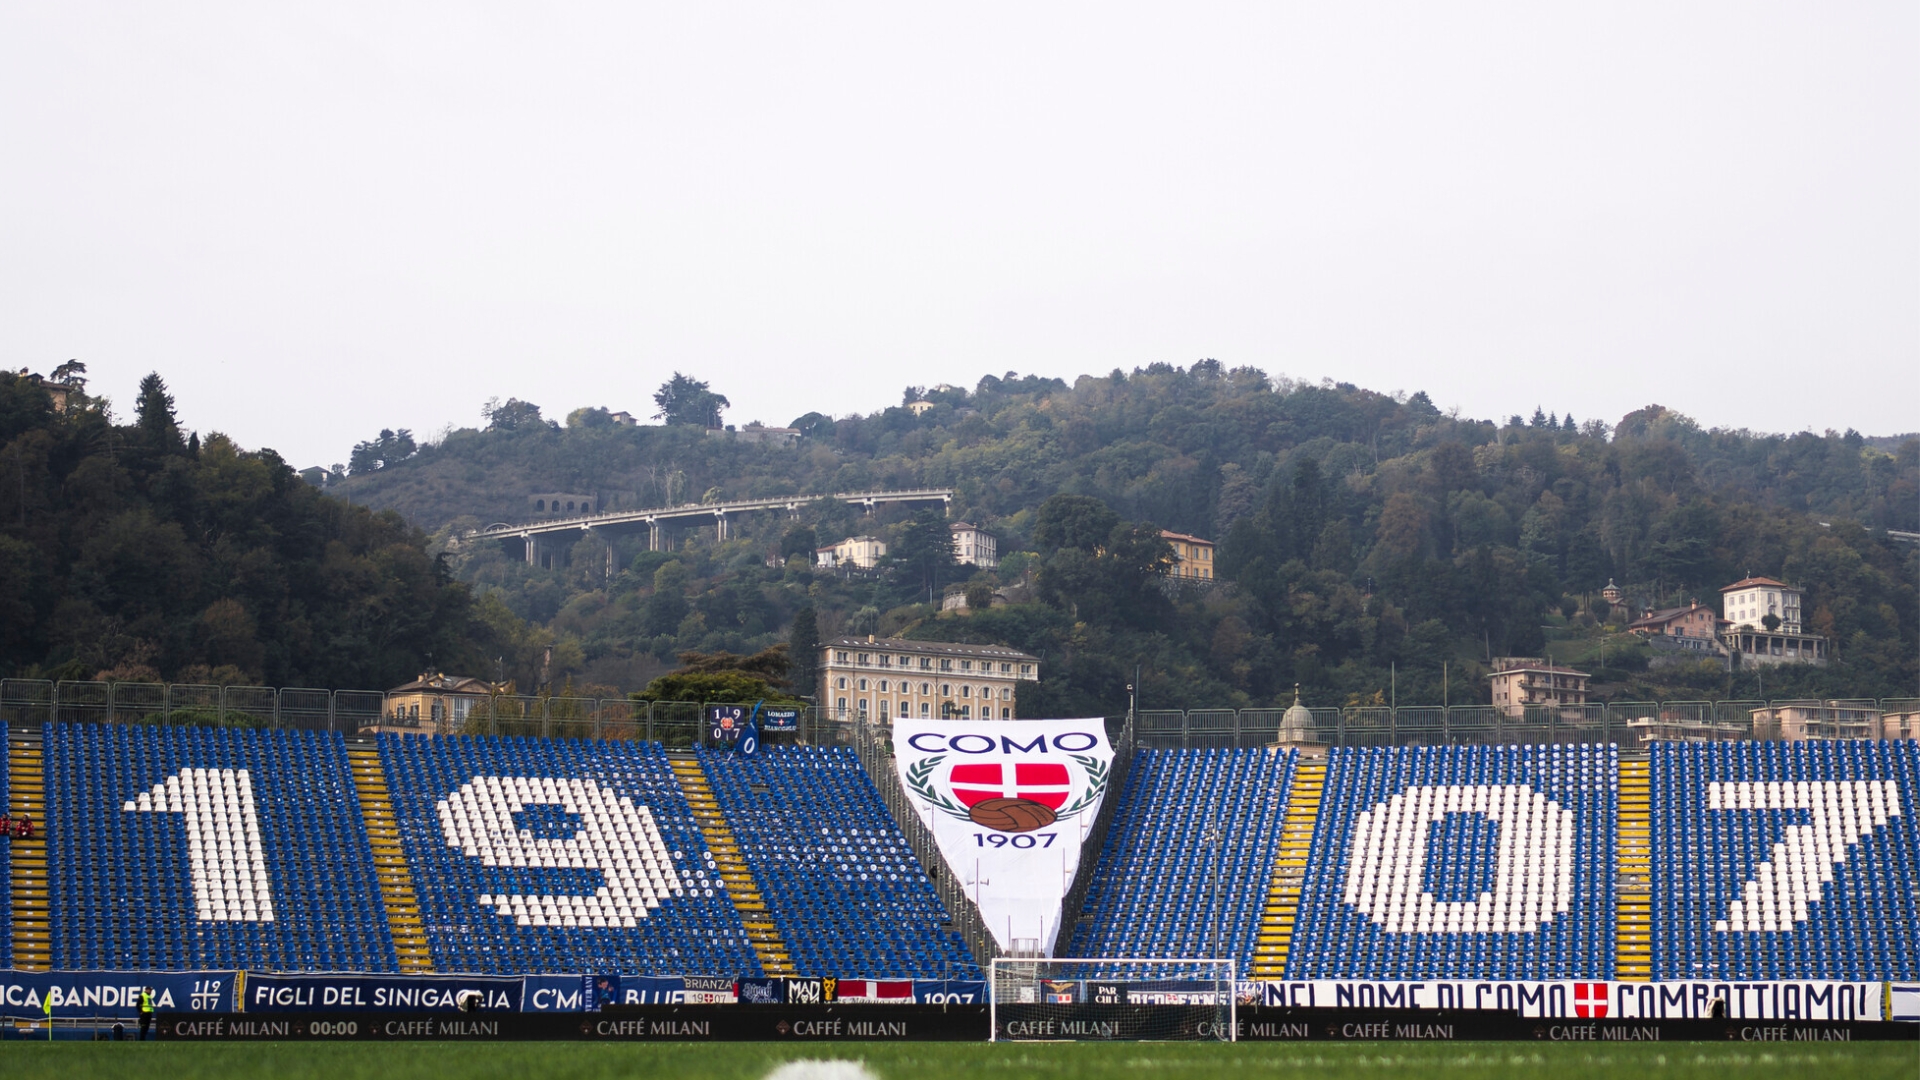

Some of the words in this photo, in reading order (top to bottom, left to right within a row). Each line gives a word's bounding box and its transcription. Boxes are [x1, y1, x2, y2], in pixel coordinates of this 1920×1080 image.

[714, 709, 720, 719] 1
[733, 709, 740, 719] 9
[714, 728, 722, 738] 0
[733, 728, 740, 738] 7
[908, 732, 1098, 754] COMO
[973, 833, 1058, 849] 1907
[195, 981, 200, 992] 1
[212, 980, 220, 992] 9
[686, 979, 732, 990] BRIANZA
[789, 980, 820, 1001] MAD
[1098, 986, 1116, 994] PAR
[192, 998, 201, 1010] 0
[210, 998, 218, 1010] 7
[256, 986, 314, 1006] FIGLI
[324, 987, 366, 1006] DEL
[374, 988, 510, 1008] SINIGAIA
[533, 988, 582, 1009] C'M
[692, 994, 704, 1003] 19
[714, 994, 726, 1004] 07
[1336, 984, 1425, 1008] NOME
[1438, 984, 1464, 1009] DI
[1476, 984, 1566, 1018] COMO
[176, 1018, 223, 1036] CAFFÉ
[229, 1022, 289, 1036] MILANI
[310, 1022, 358, 1036] 00:00
[386, 1018, 433, 1036] CAFFÉ
[439, 1022, 498, 1036] MILANI
[597, 1018, 644, 1035] CAFFÉ
[650, 1022, 710, 1035] MILANI
[794, 1018, 841, 1036] CAFFÉ
[848, 1022, 906, 1036] MILANI
[1007, 1018, 1054, 1036] CAFFÉ
[1060, 1022, 1119, 1036] MILANI
[1250, 1022, 1308, 1036] MILANI
[1342, 1020, 1390, 1038] CAFFÉ
[1396, 1024, 1454, 1038] MILANI
[1550, 1022, 1596, 1040] CAFFÉ
[1602, 1026, 1660, 1040] MILANI
[1741, 1024, 1787, 1041] CAFFÉ
[1794, 1028, 1850, 1041] MILANI
